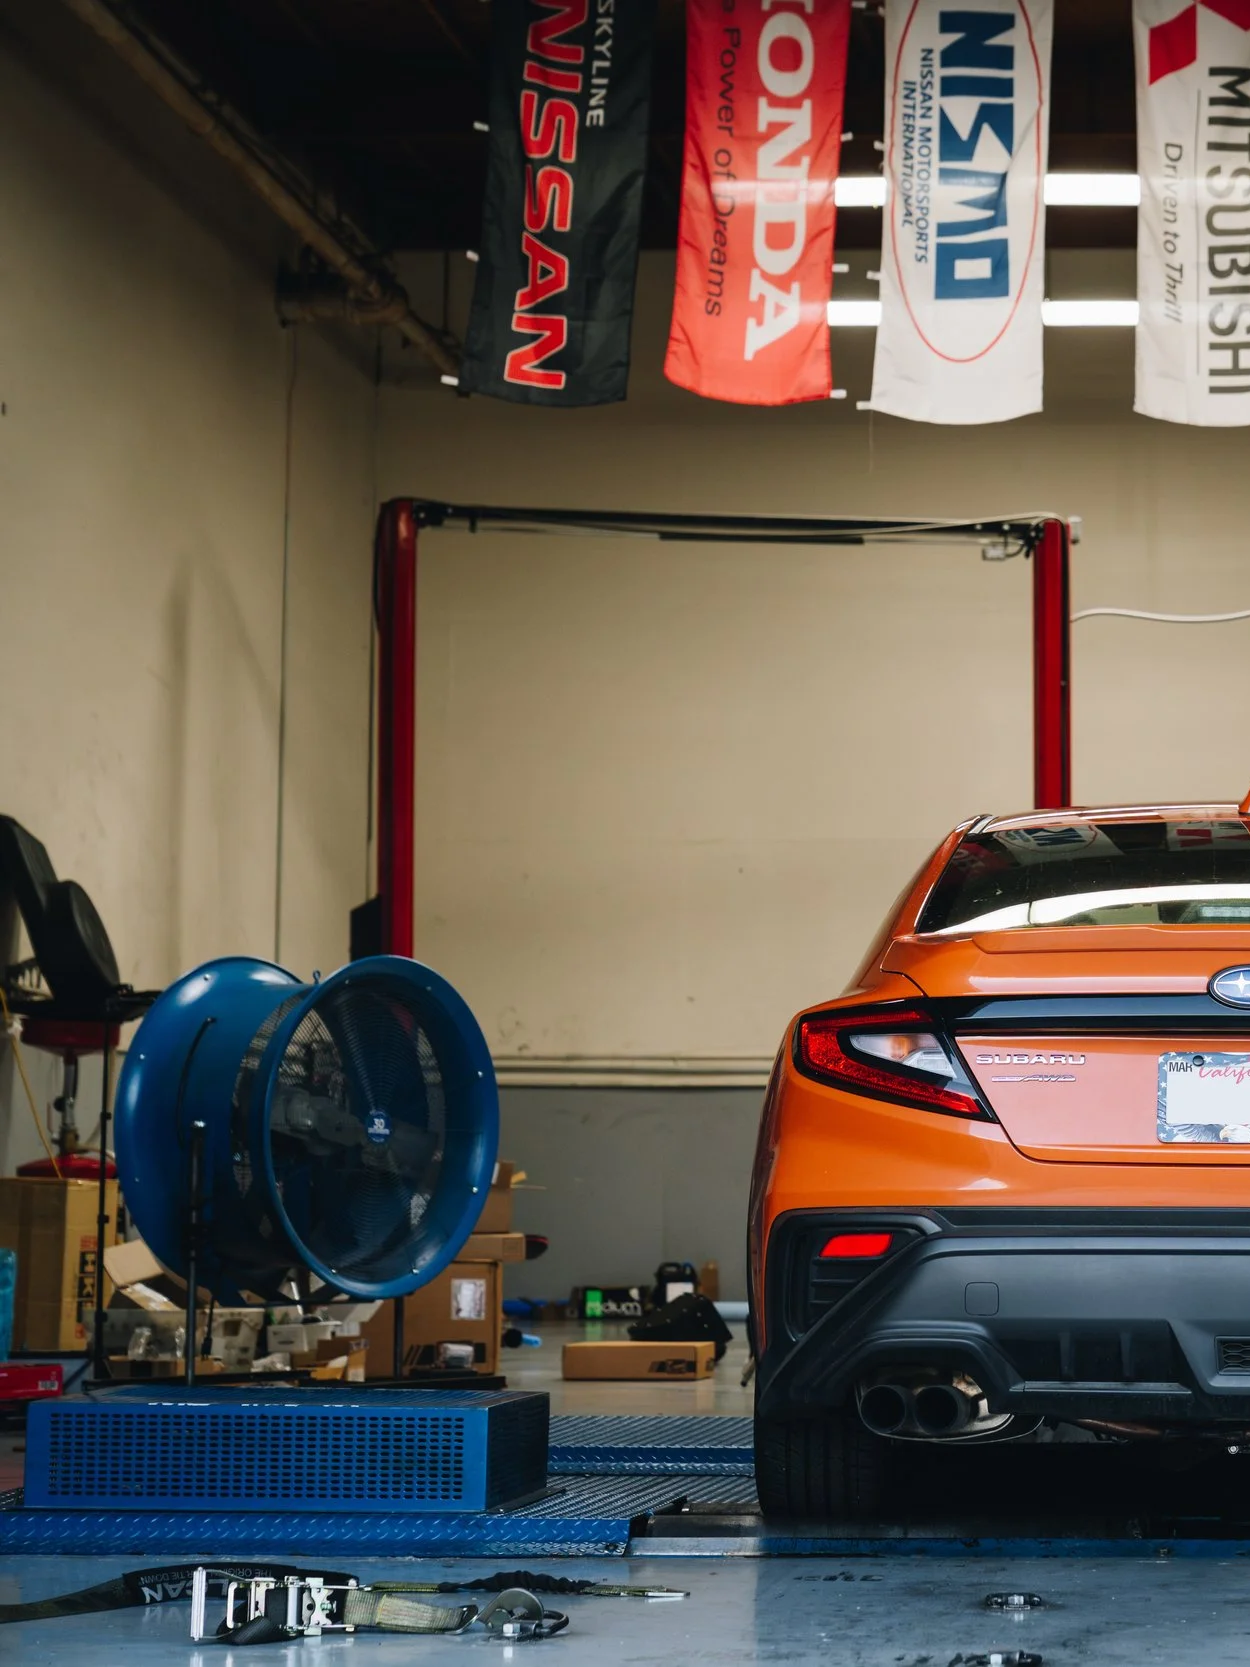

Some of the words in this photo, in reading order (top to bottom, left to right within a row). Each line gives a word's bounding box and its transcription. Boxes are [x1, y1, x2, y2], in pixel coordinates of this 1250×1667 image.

[585, 0, 614, 127] SKYLINE
[717, 27, 741, 138] Power
[919, 48, 934, 119] NISSAN
[504, 0, 588, 390] NISSAN
[714, 148, 737, 185] of
[744, 0, 815, 361] ONDA
[902, 80, 918, 227] INTERNATIONAL
[914, 126, 932, 264] MOTORSPORTS
[934, 10, 1016, 300] NISMO
[1163, 142, 1184, 224] Driven
[705, 195, 736, 317] Dreams
[1163, 231, 1182, 255] to
[1163, 262, 1184, 324] Thrill
[975, 1054, 1086, 1065] SUBARU
[1168, 1061, 1193, 1073] MAR
